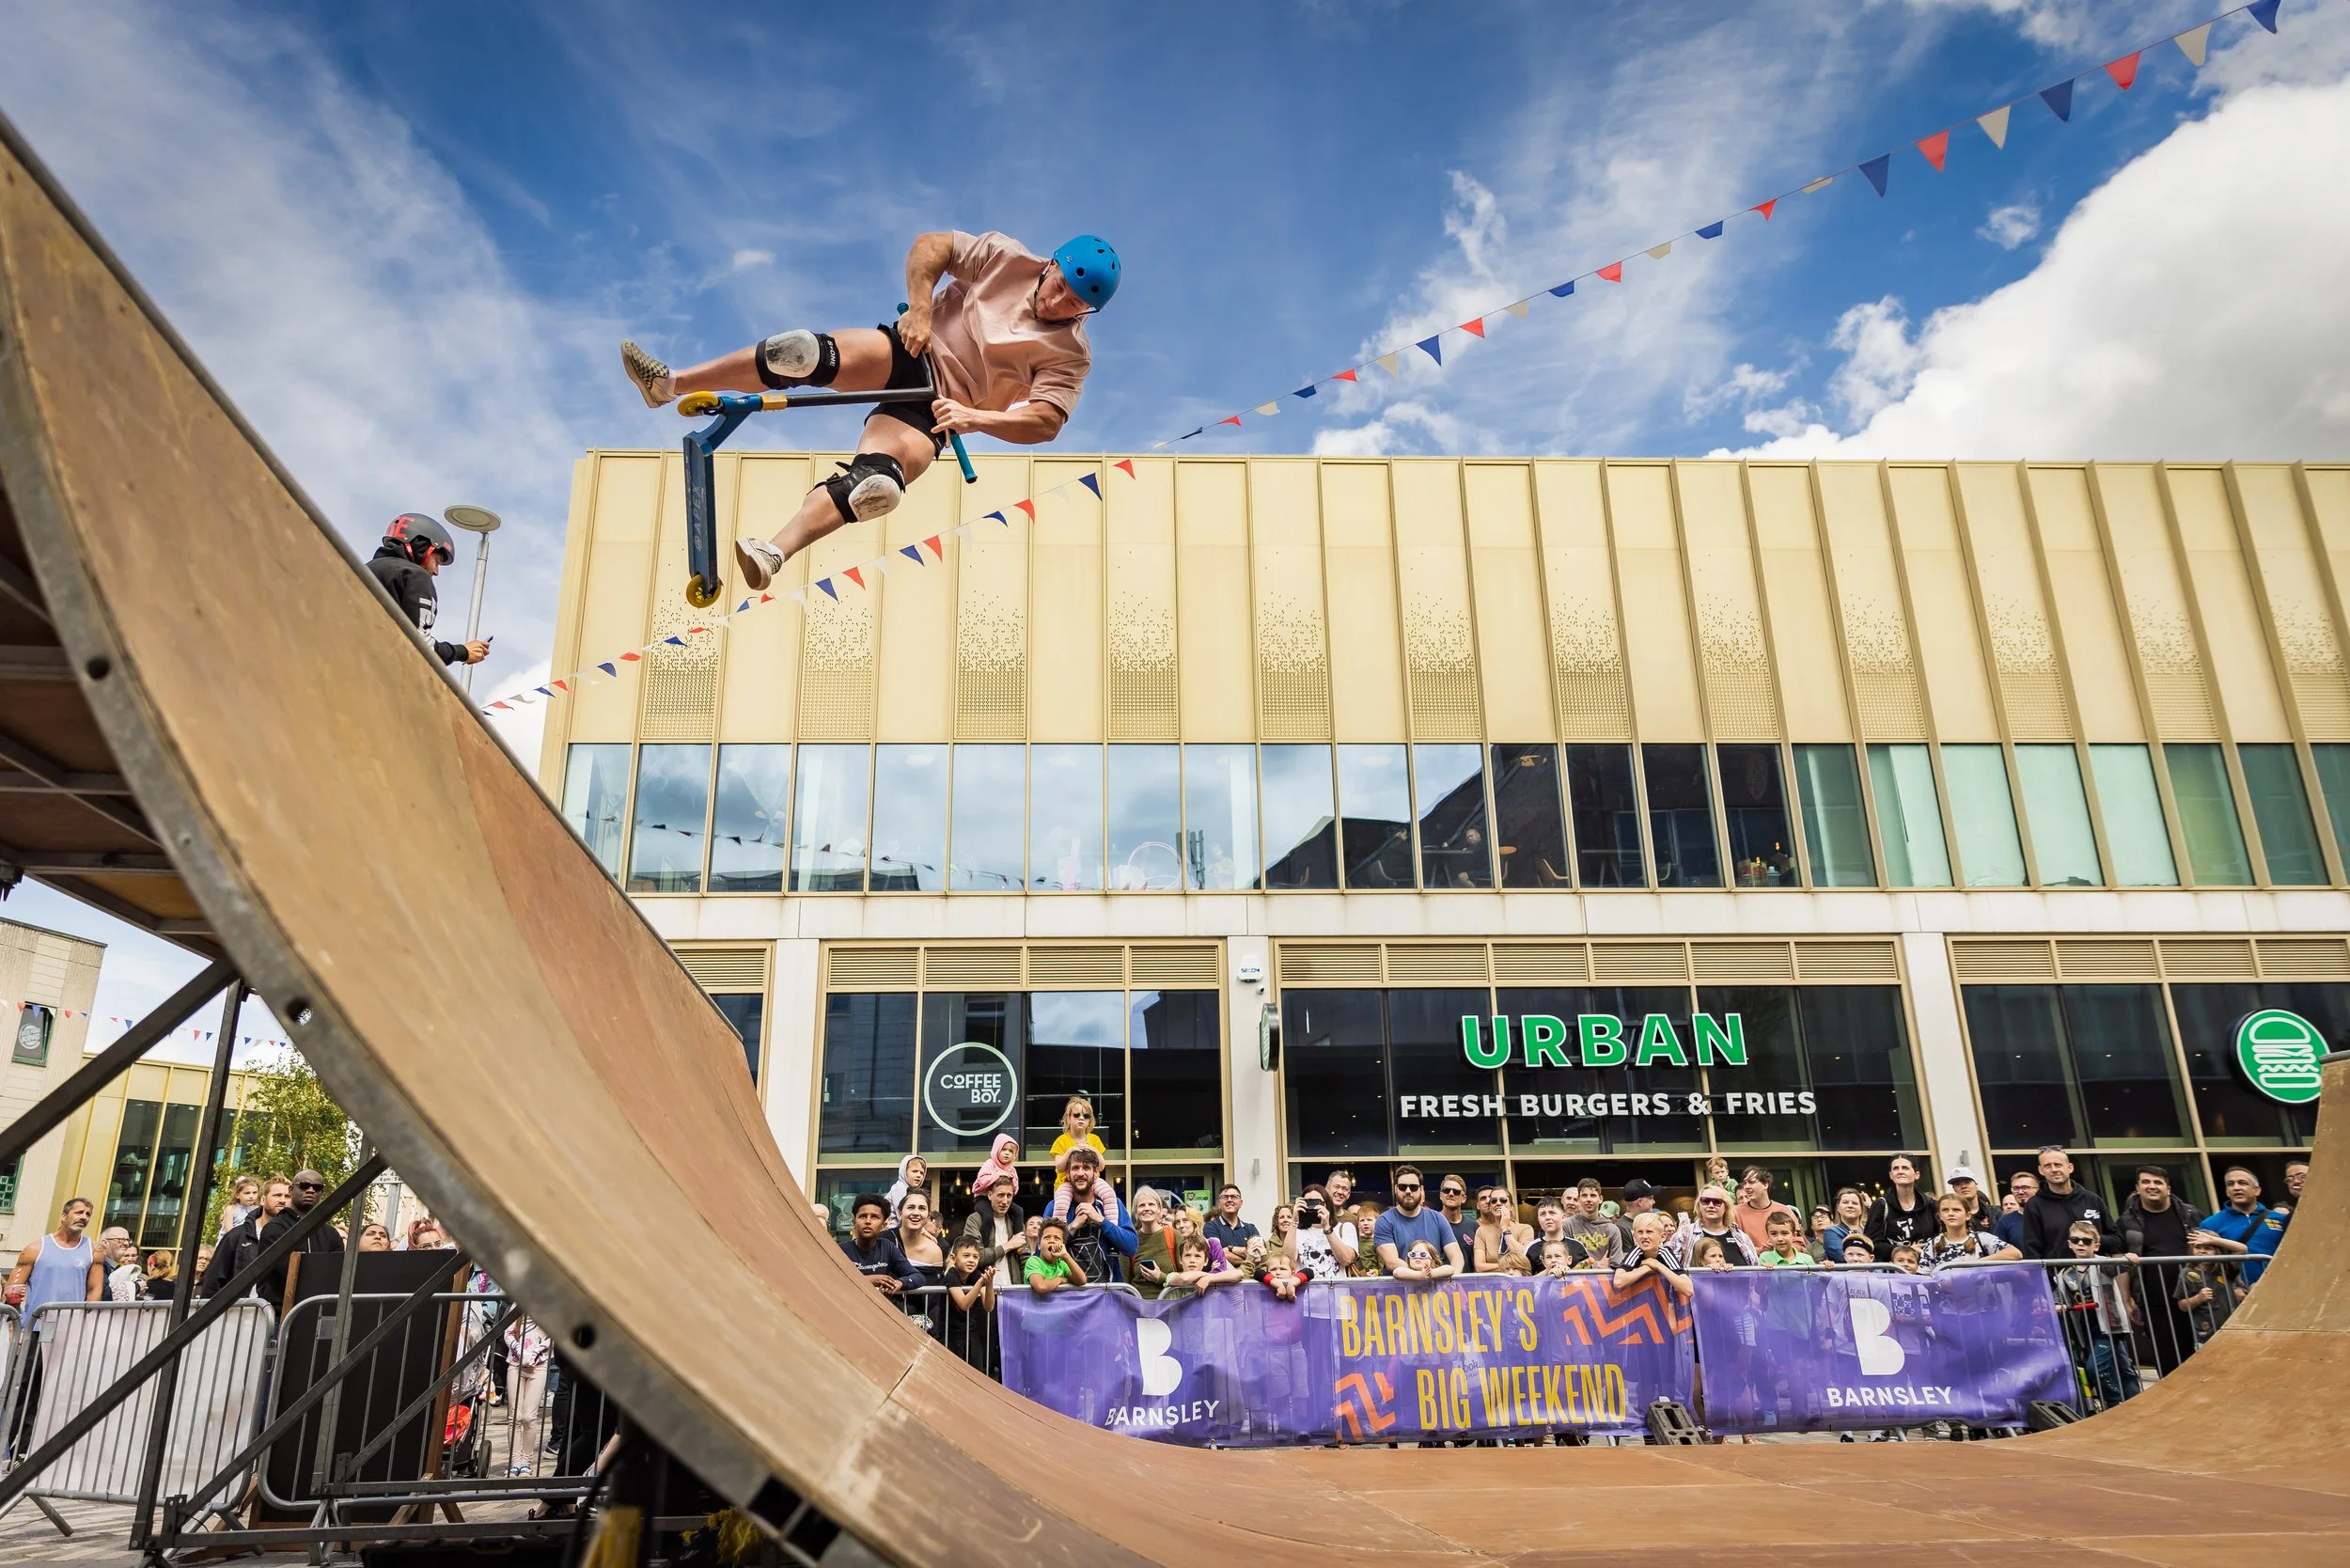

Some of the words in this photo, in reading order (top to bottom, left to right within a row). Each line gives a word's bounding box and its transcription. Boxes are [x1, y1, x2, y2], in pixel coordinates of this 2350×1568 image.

[1461, 1012, 1748, 1070] URBAN
[940, 1074, 1002, 1090] COFFEE
[970, 1088, 1002, 1104] BOY.
[1400, 1093, 1506, 1118] FRESH
[1520, 1092, 1670, 1118] BURGERS
[1687, 1091, 1711, 1116] &
[1726, 1090, 1818, 1116] FRIES
[1341, 1289, 1538, 1356] BARNSLEY'S
[1417, 1368, 1472, 1430] BIG
[1479, 1363, 1626, 1427] WEEKEND
[1826, 1387, 1951, 1406] BARNSLEY
[1104, 1400, 1220, 1426] BARNSLEY
